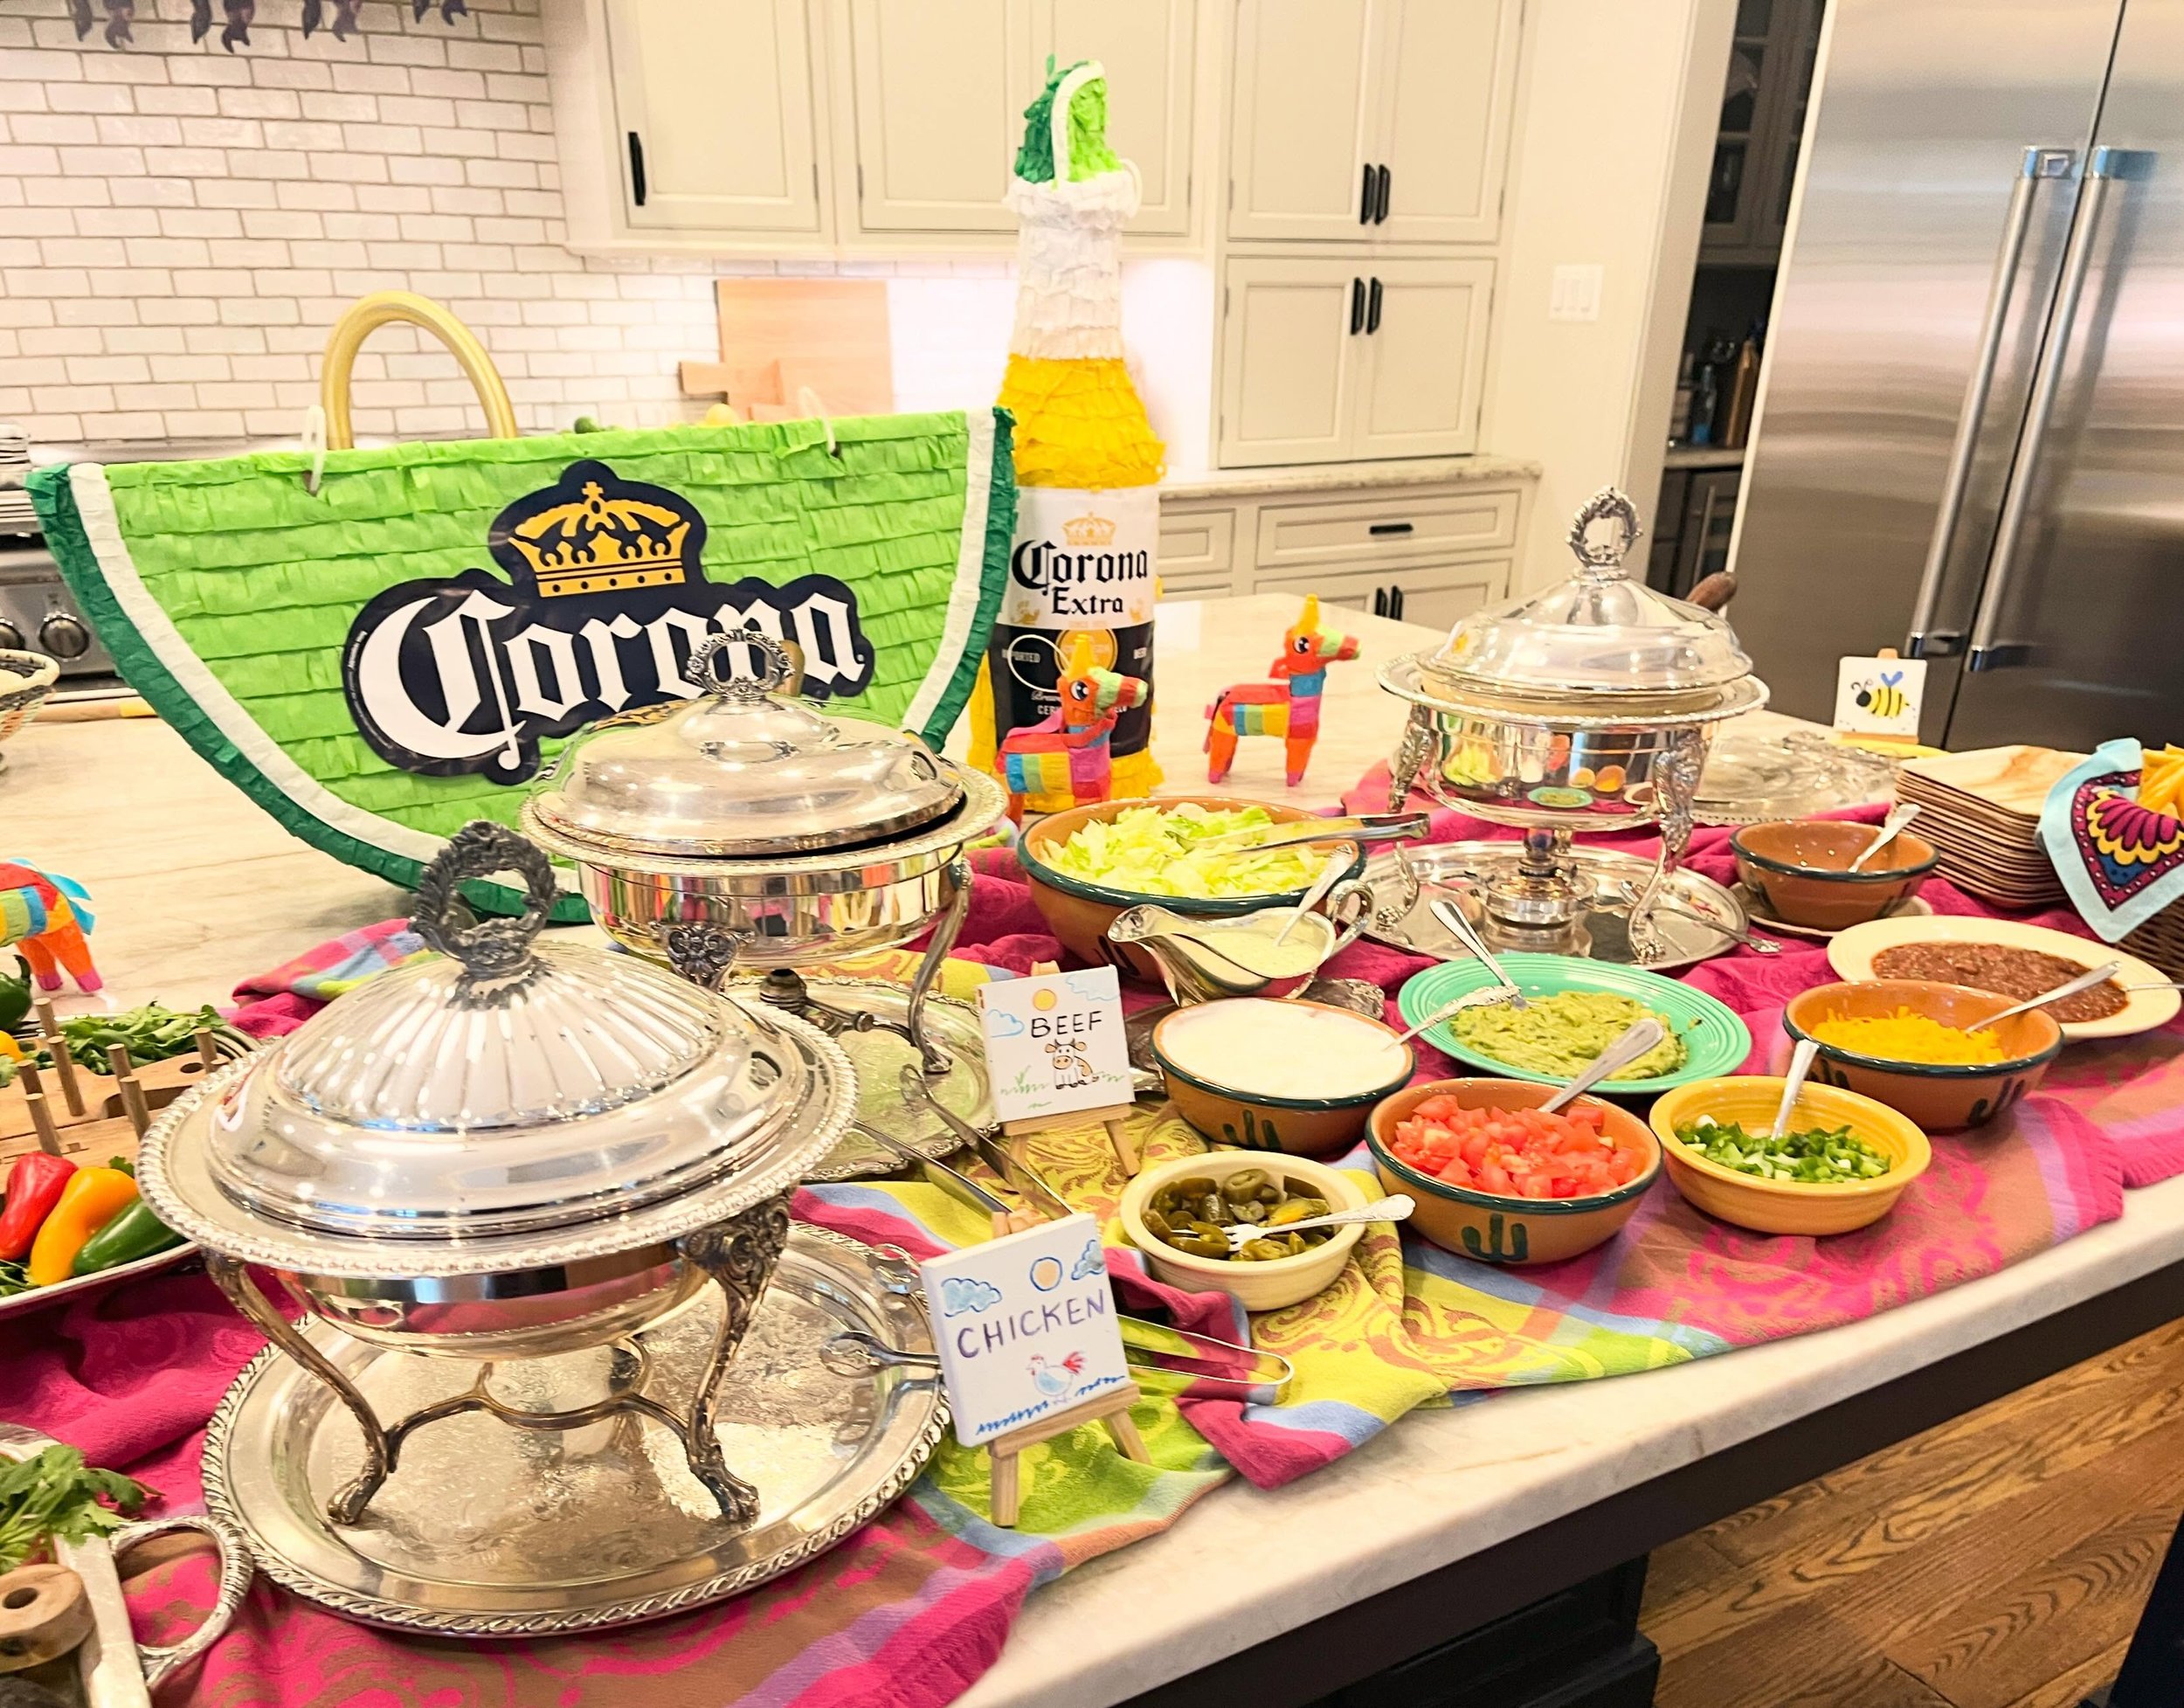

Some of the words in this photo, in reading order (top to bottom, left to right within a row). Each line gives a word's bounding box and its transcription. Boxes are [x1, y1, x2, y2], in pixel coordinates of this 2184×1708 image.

[1012, 540, 1147, 595] Corona
[1053, 586, 1124, 615] Extra
[359, 590, 865, 770] Corona
[1031, 1011, 1102, 1038] BEEF
[957, 1289, 1104, 1358] CHICKEN
